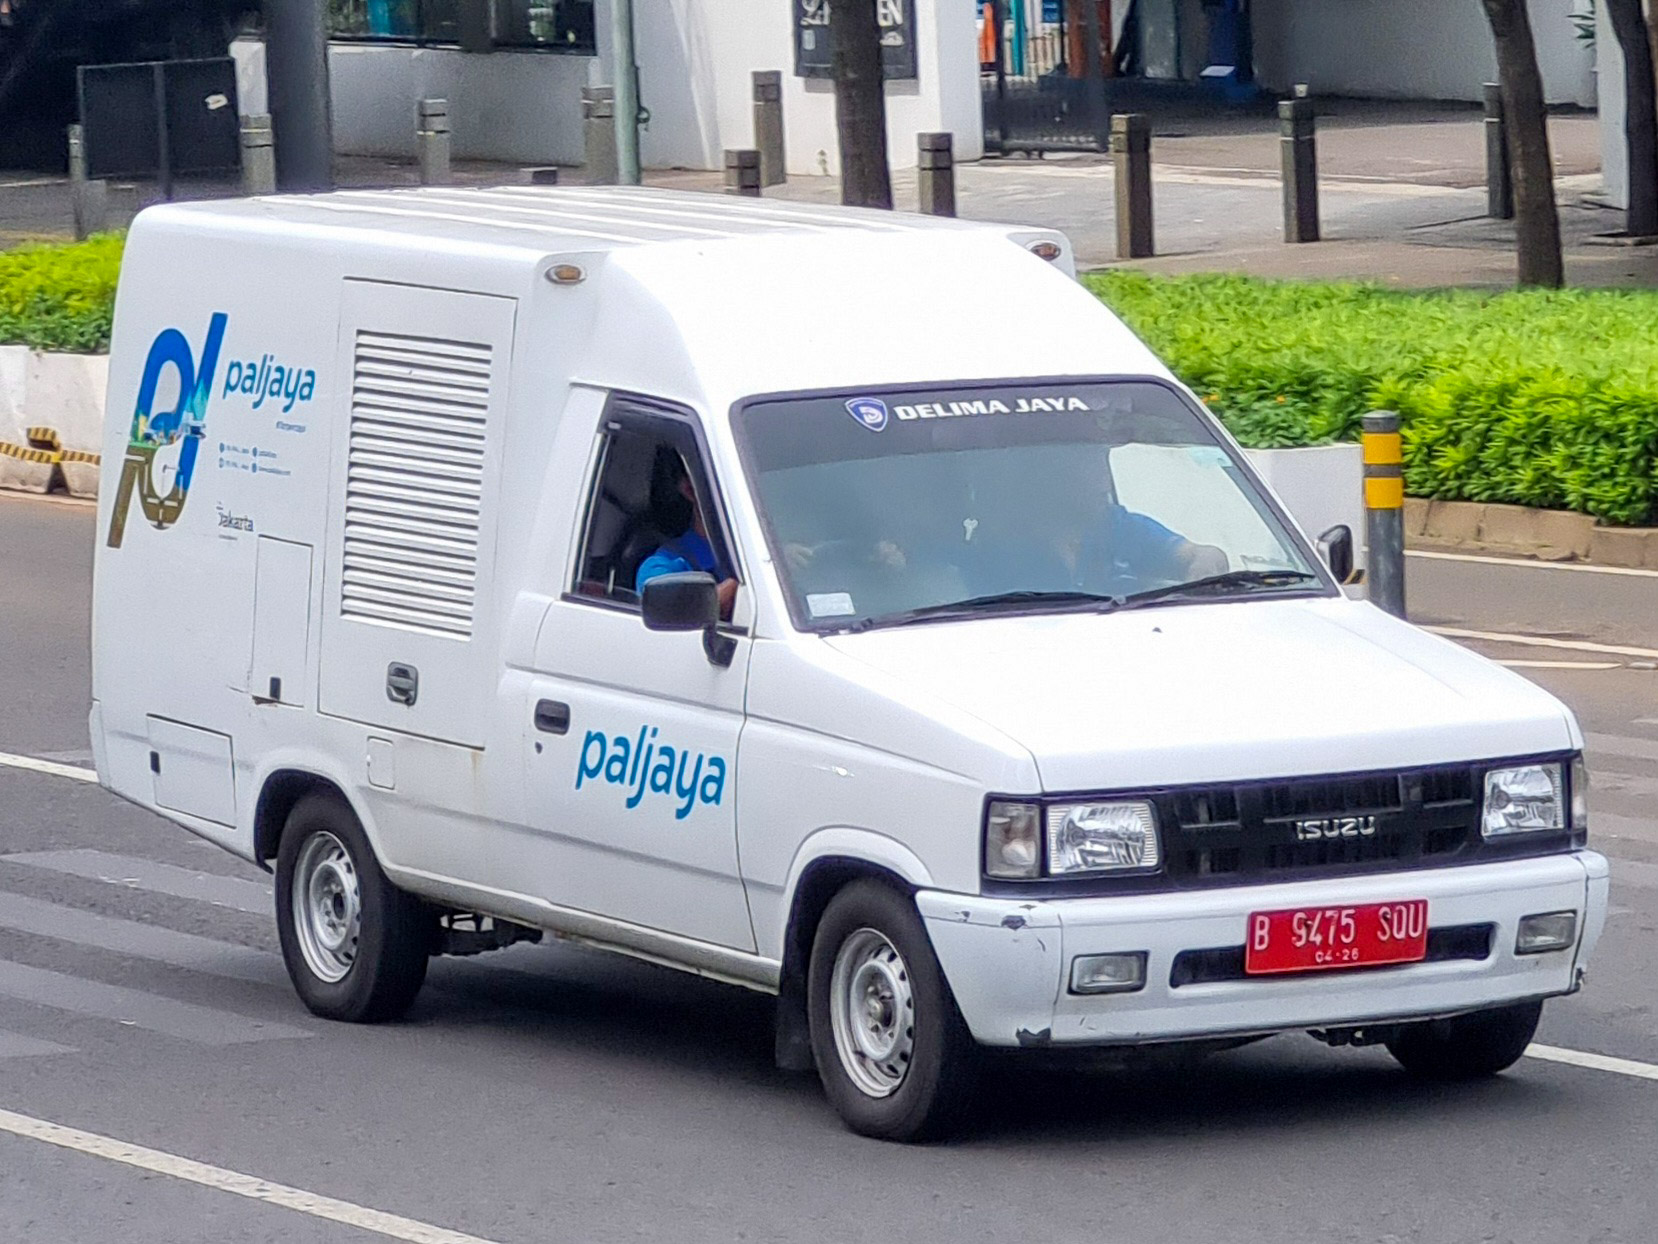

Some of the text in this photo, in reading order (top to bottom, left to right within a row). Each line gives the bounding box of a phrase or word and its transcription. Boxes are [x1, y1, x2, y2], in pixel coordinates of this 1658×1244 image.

[223, 353, 316, 413] paljaya
[893, 397, 1090, 421] DELIMA JAYA
[575, 725, 726, 820] paljaya
[1296, 816, 1375, 840] ISUZU
[1254, 915, 1271, 951] B
[1291, 909, 1356, 947] 9475
